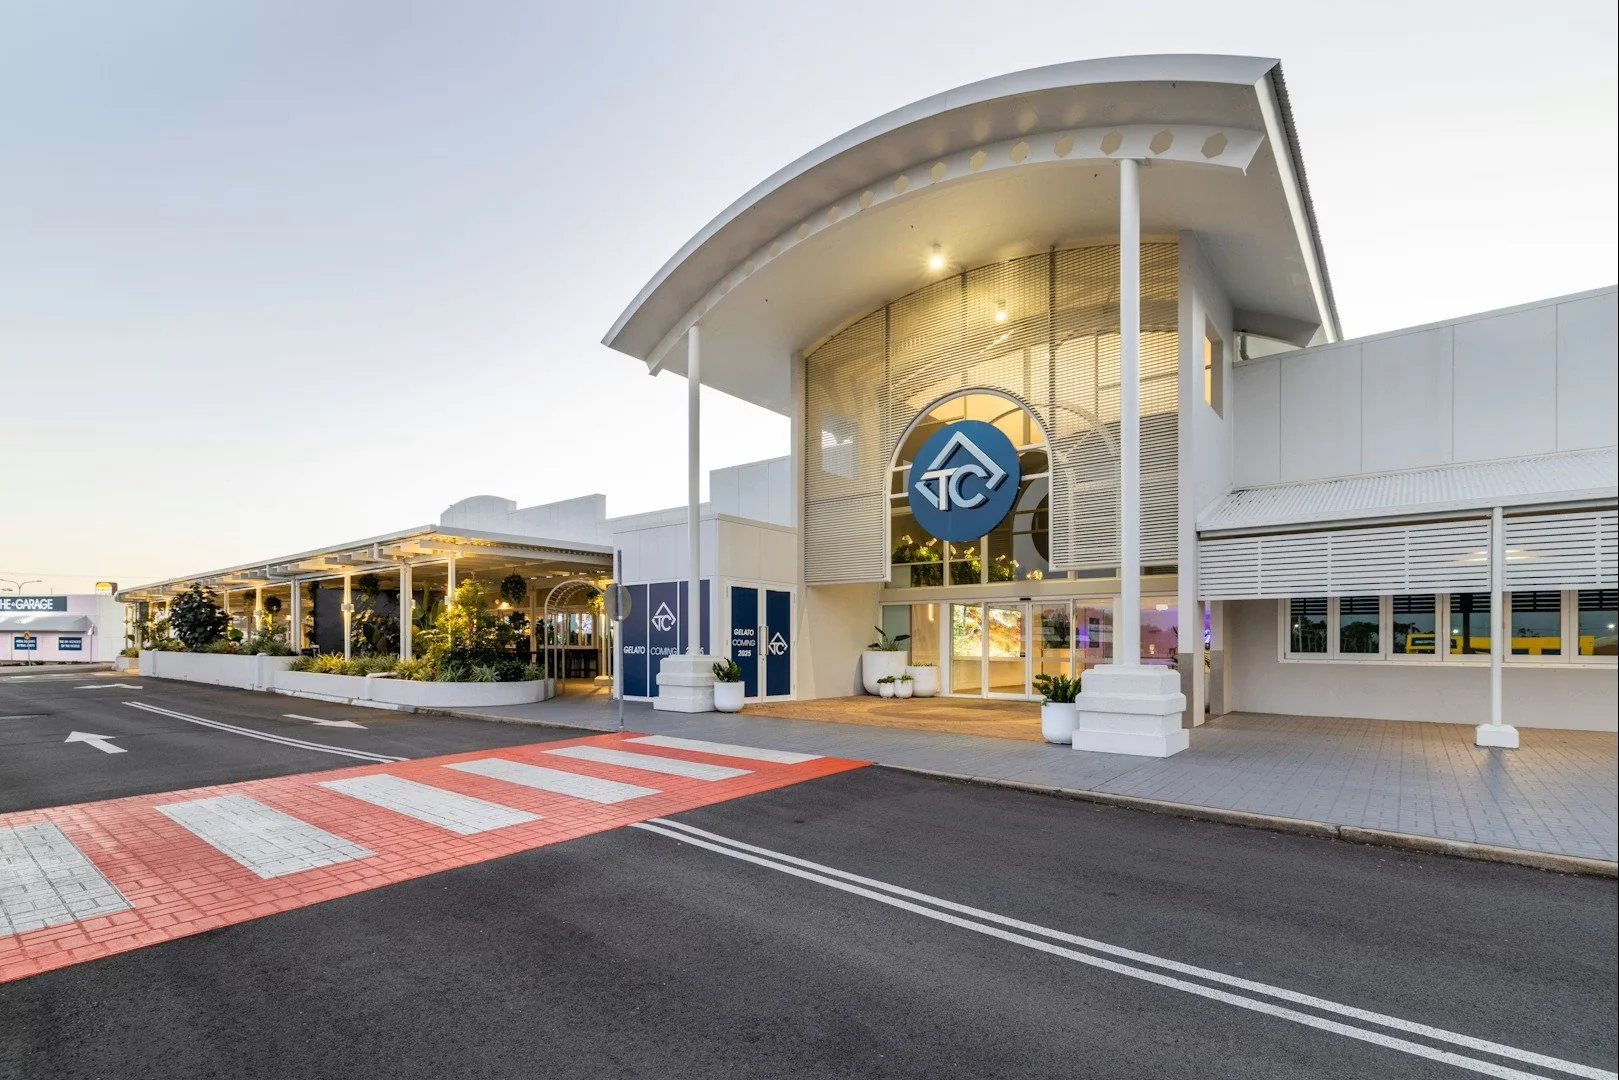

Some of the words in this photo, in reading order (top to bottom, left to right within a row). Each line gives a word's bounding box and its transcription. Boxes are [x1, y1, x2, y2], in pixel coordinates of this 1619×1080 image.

[15, 599, 53, 609] GARAGE
[623, 645, 646, 654] GELATO
[650, 647, 678, 655] COMING
